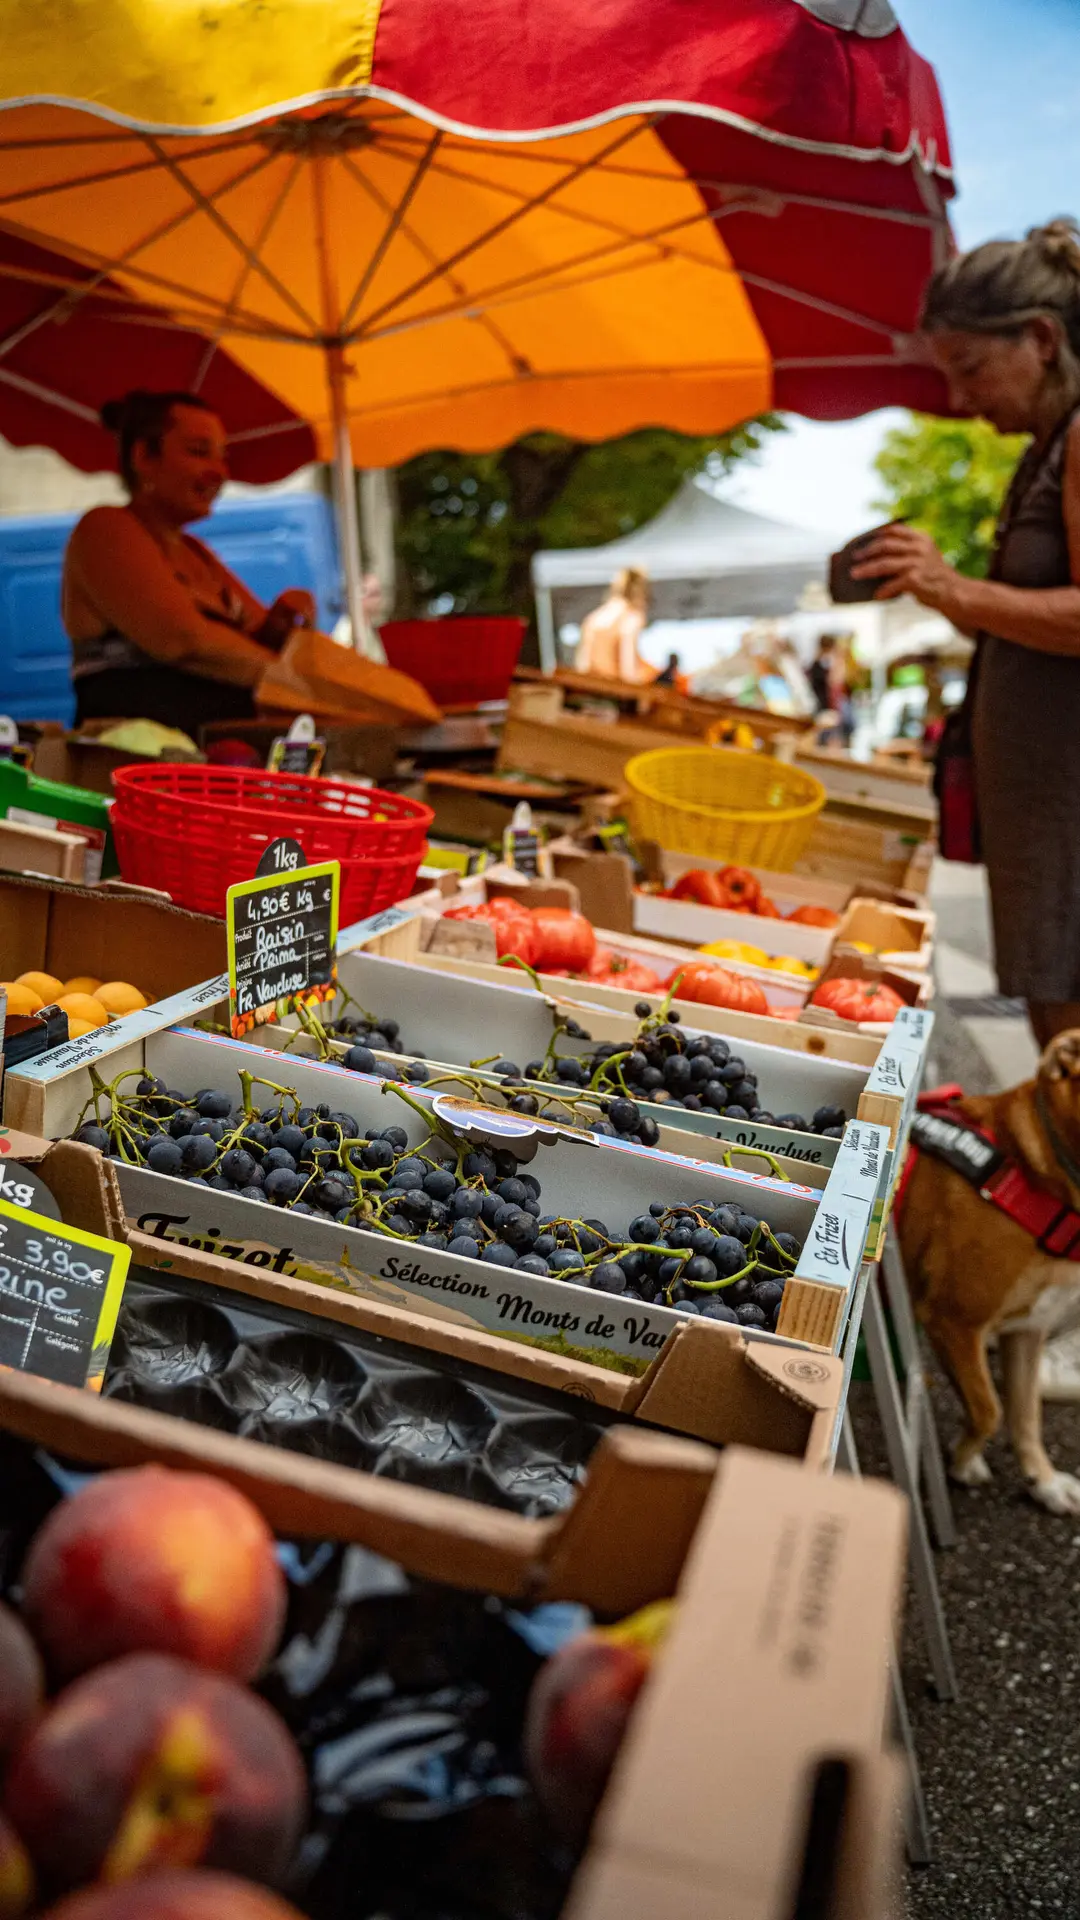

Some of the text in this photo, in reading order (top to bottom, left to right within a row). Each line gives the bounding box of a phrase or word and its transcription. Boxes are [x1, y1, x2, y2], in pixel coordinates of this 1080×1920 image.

[273, 842, 298, 871] 1kg
[248, 891, 291, 921] 4,90€
[235, 919, 305, 951] Produit Raisin
[257, 972, 307, 1004] Vaucluse
[814, 1213, 841, 1266] Ets Frizet
[25, 1239, 105, 1284] 3,90€
[380, 1257, 490, 1299] Sélection
[496, 1293, 580, 1332] Monts
[585, 1314, 616, 1339] de
